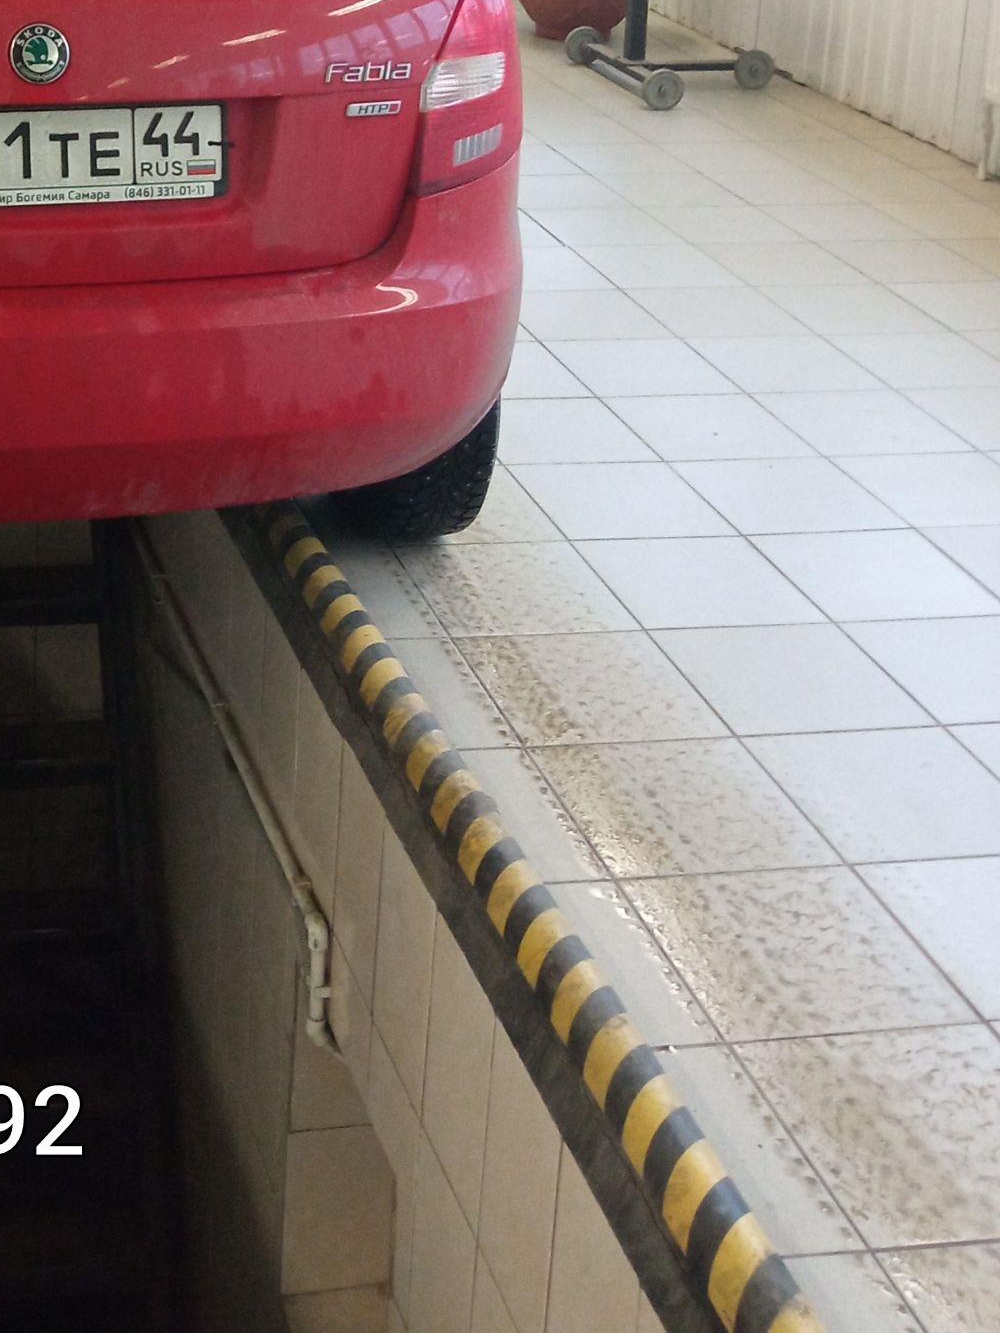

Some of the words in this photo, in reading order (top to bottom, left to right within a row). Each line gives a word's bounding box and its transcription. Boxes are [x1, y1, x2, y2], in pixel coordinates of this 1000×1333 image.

[357, 103, 389, 115] HTP
[142, 110, 200, 158] 44
[140, 160, 184, 177] RUS
[15, 190, 66, 203] Богемия
[67, 188, 111, 202] Самара
[124, 186, 154, 200] (846)
[156, 184, 206, 197] 331-01-11
